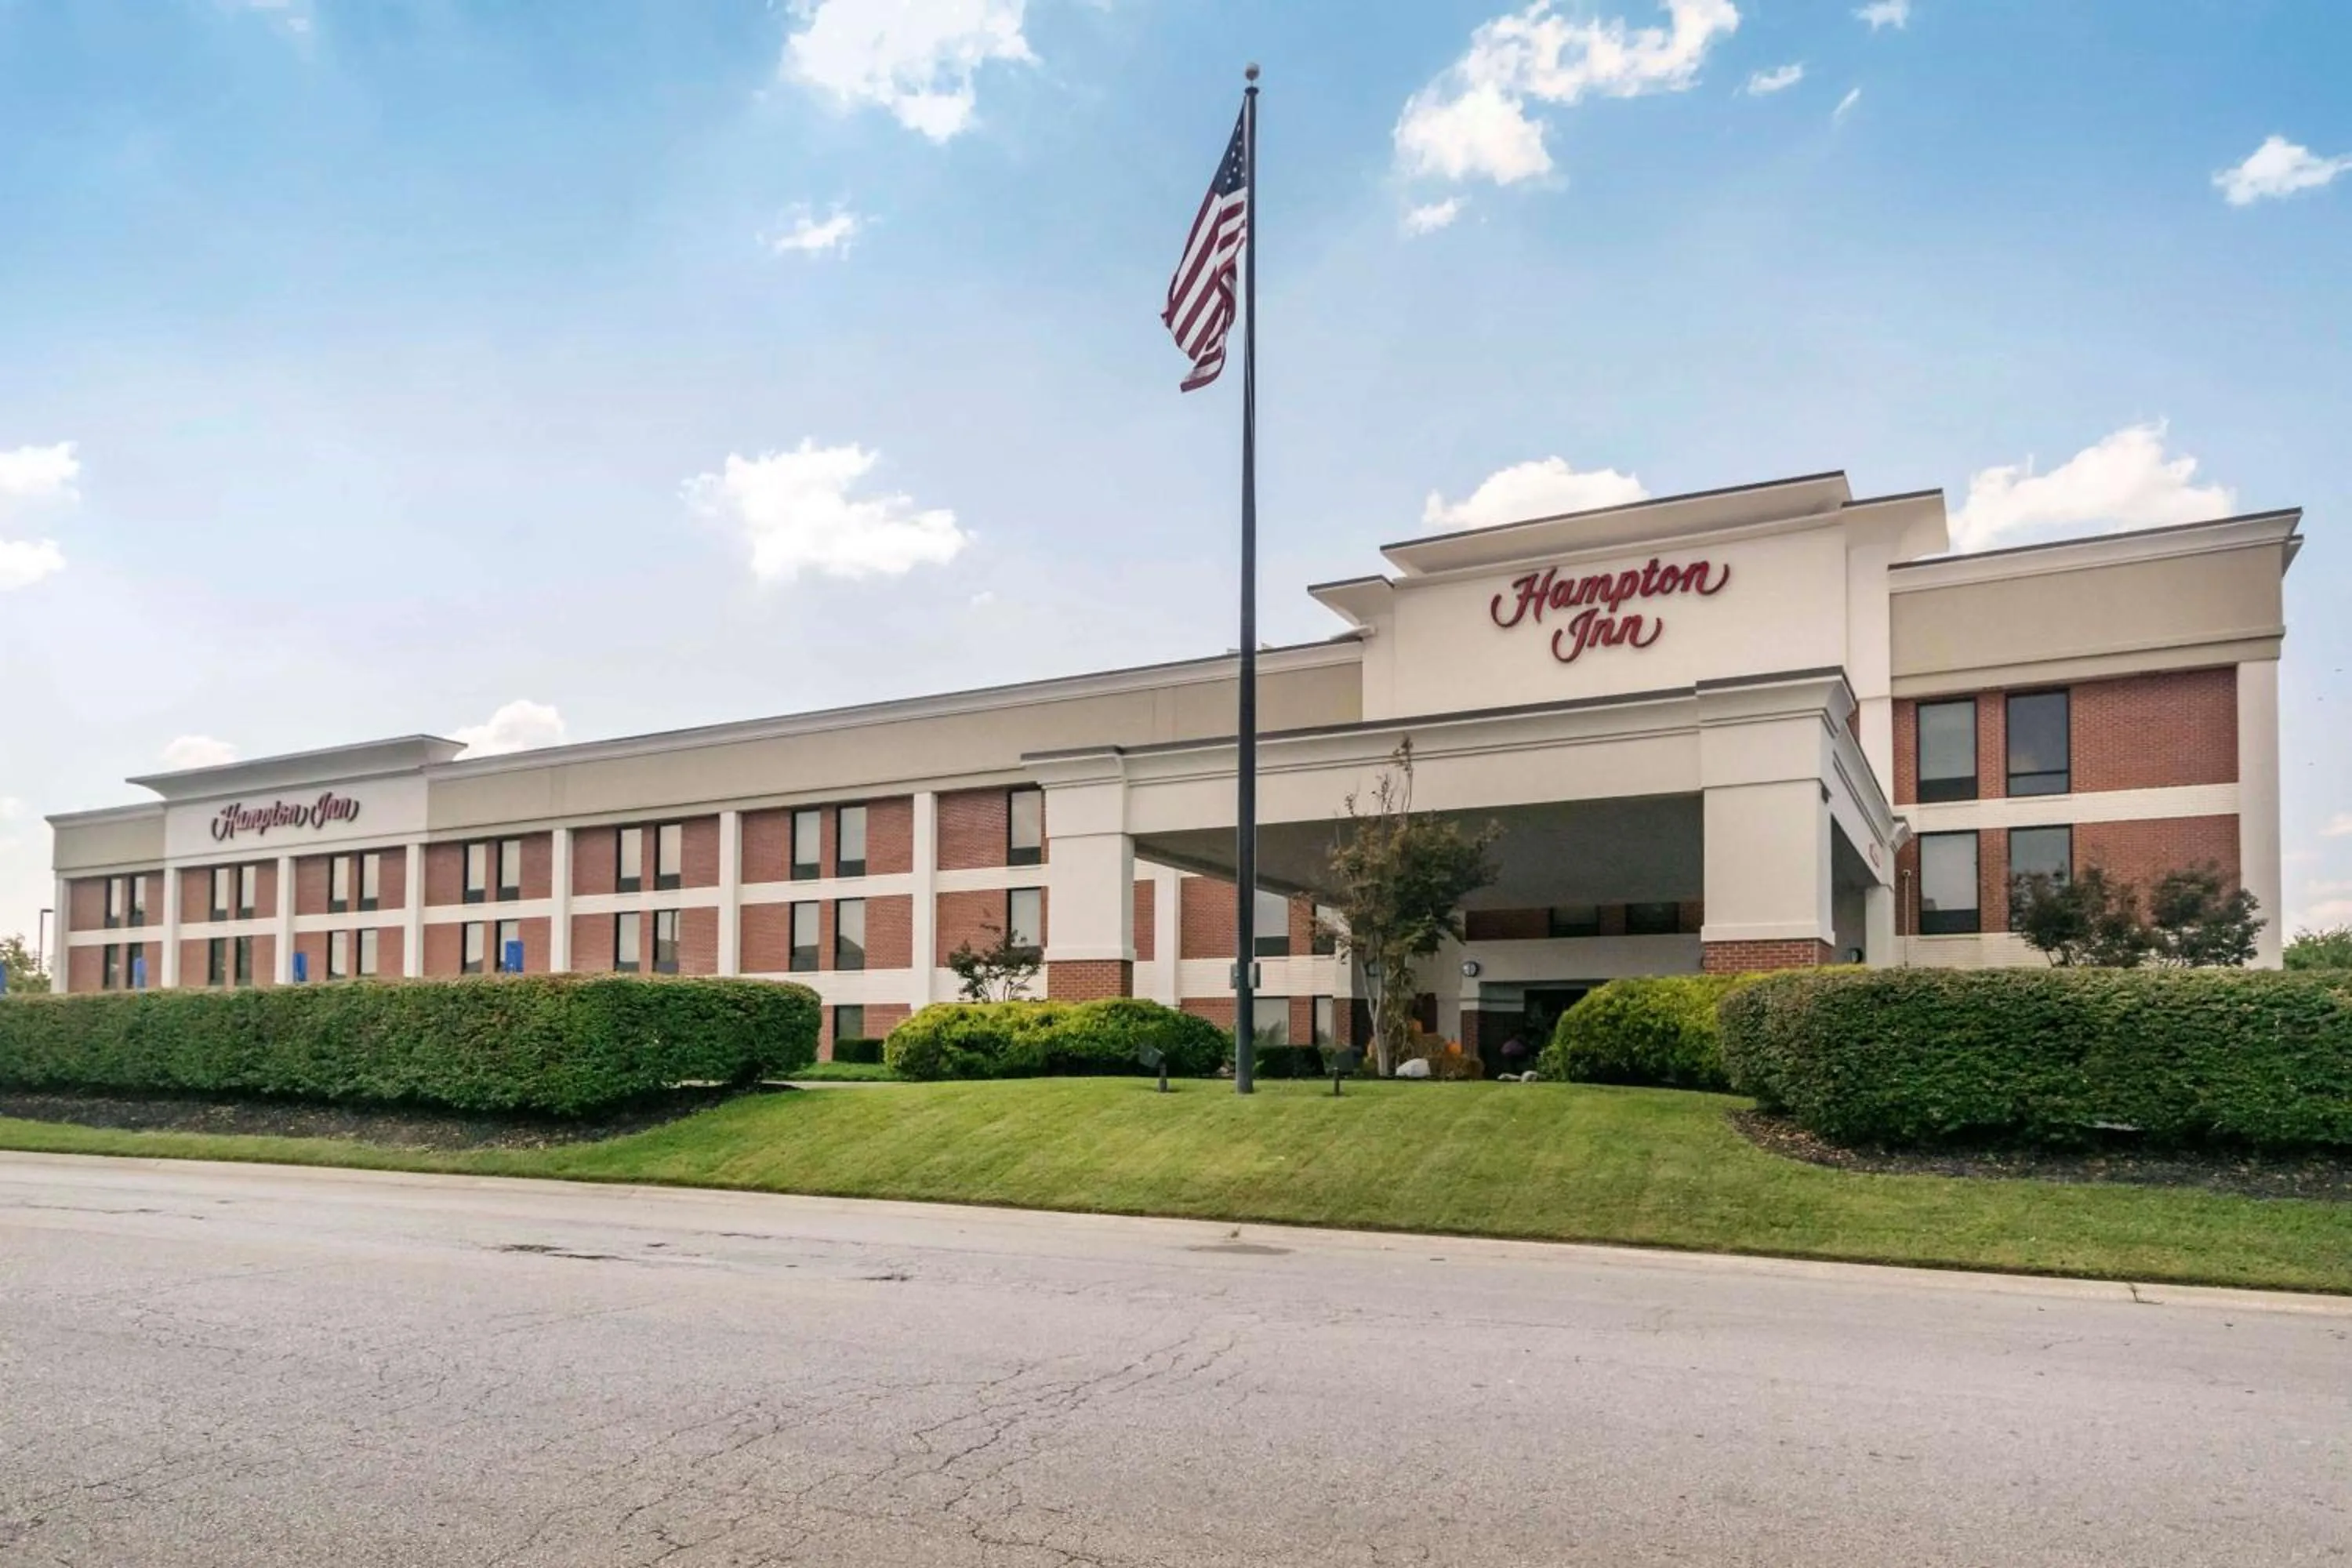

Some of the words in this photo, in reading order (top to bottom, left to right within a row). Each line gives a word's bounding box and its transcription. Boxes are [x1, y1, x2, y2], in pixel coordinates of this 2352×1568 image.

[1491, 557, 1730, 628] Hampton
[1552, 608, 1663, 663] Inn
[211, 800, 308, 841] Hampton
[310, 791, 360, 829] Inn
